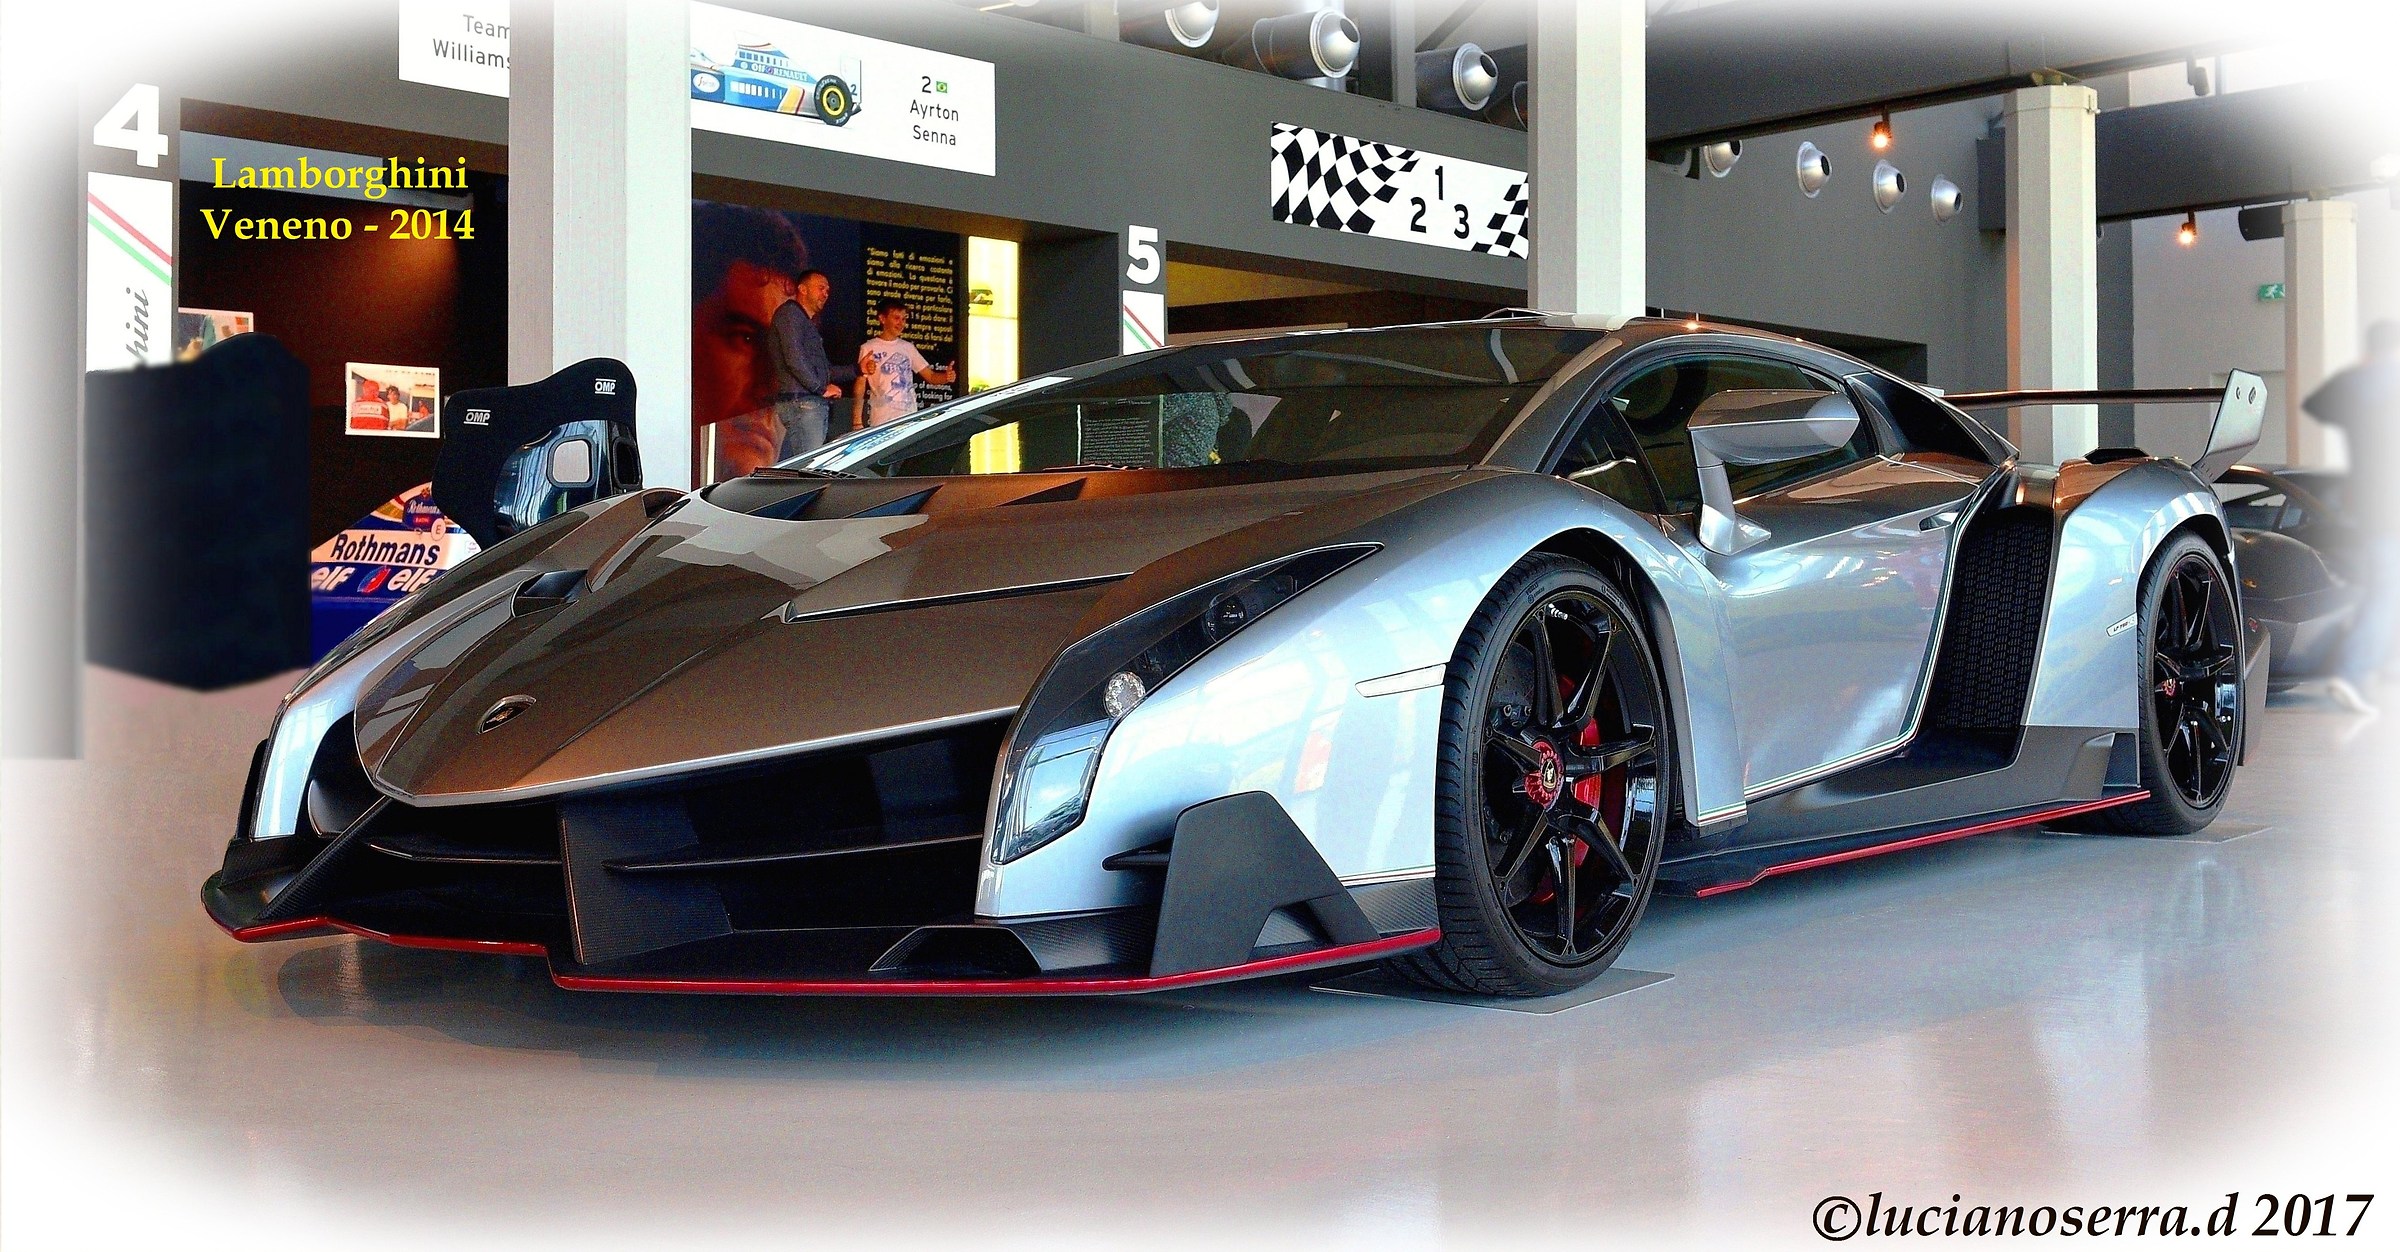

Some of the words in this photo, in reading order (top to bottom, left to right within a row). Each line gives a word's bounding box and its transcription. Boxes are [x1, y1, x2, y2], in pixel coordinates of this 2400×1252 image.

[773, 66, 808, 81] RENAULT
[922, 76, 931, 93] 2
[910, 99, 959, 121] Ayrton
[93, 83, 168, 168] 4
[913, 125, 956, 146] Senna
[1434, 166, 1444, 201] 1
[1410, 197, 1427, 234] 2
[1453, 204, 1470, 240] 3
[1127, 225, 1160, 285] 5
[594, 381, 617, 393] OMP
[463, 411, 491, 423] OMP
[330, 533, 440, 566] Rothmans
[311, 566, 356, 592] elf
[387, 568, 438, 592] elf
